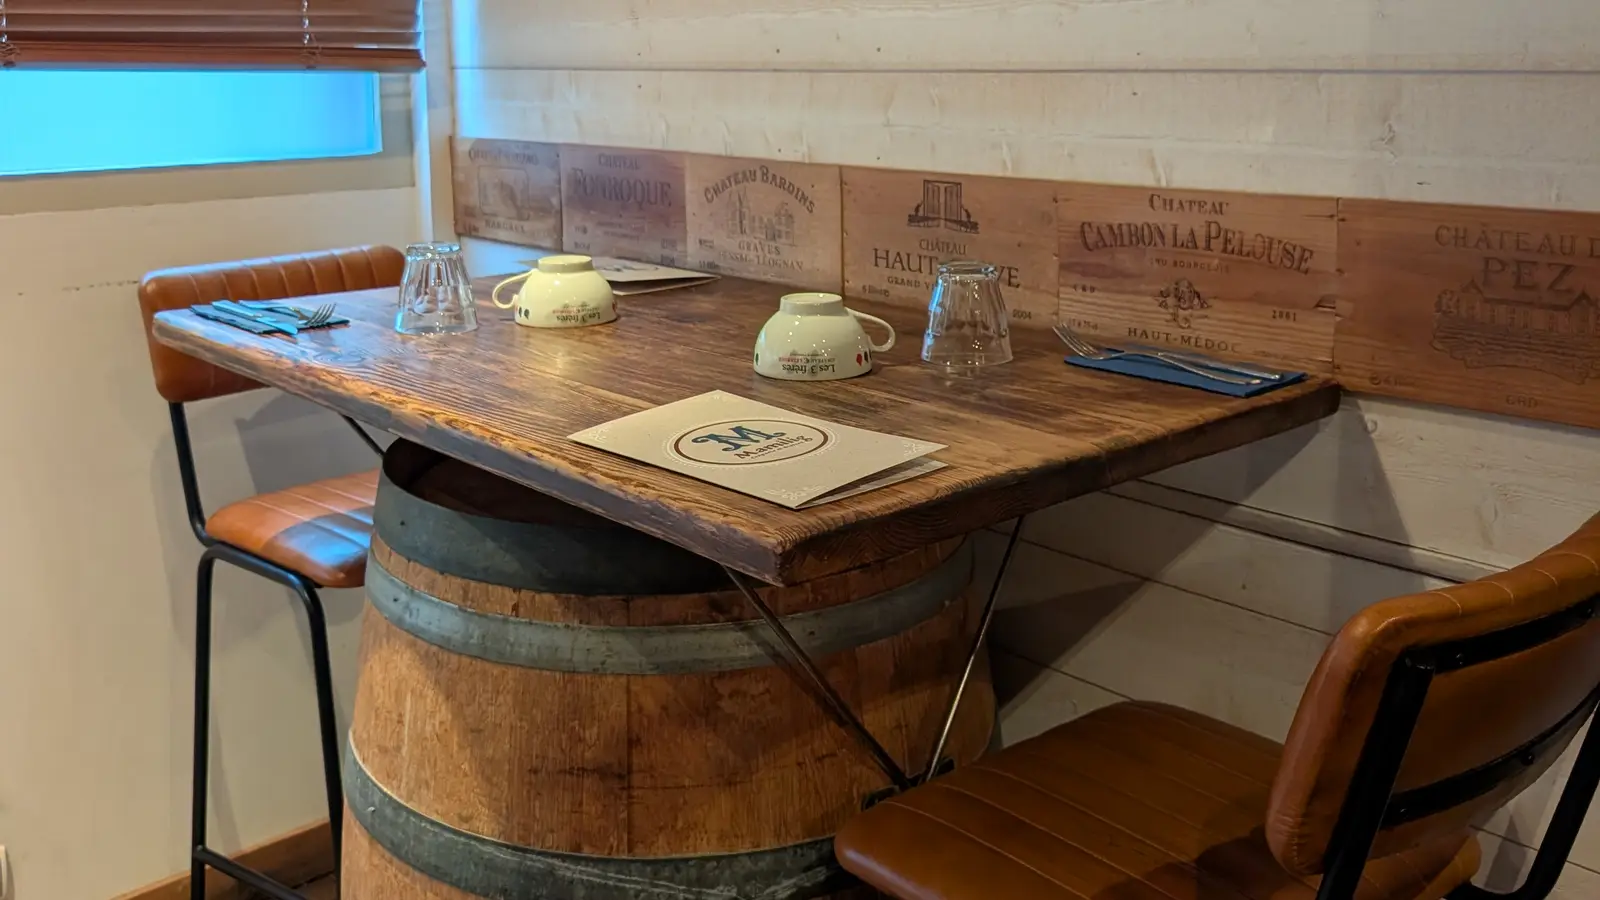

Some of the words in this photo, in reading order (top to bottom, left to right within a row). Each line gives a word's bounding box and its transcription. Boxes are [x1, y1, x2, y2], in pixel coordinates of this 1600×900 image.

[704, 169, 758, 204] CHATEAU
[759, 165, 816, 214] BARDINS
[1149, 193, 1230, 216] CHATEAU
[738, 240, 781, 256] GRAVES
[1080, 221, 1166, 251] CAMBON
[1172, 223, 1199, 251] LA
[1204, 220, 1315, 275] PELOUSE
[1434, 223, 1577, 257] CHÂTEAU
[873, 248, 939, 276] HAUT
[887, 275, 921, 289] GRAND
[1482, 256, 1576, 294] PEZ
[781, 364, 808, 374] frères
[810, 364, 818, 373] 3
[819, 364, 836, 373] Les
[691, 425, 787, 453] M
